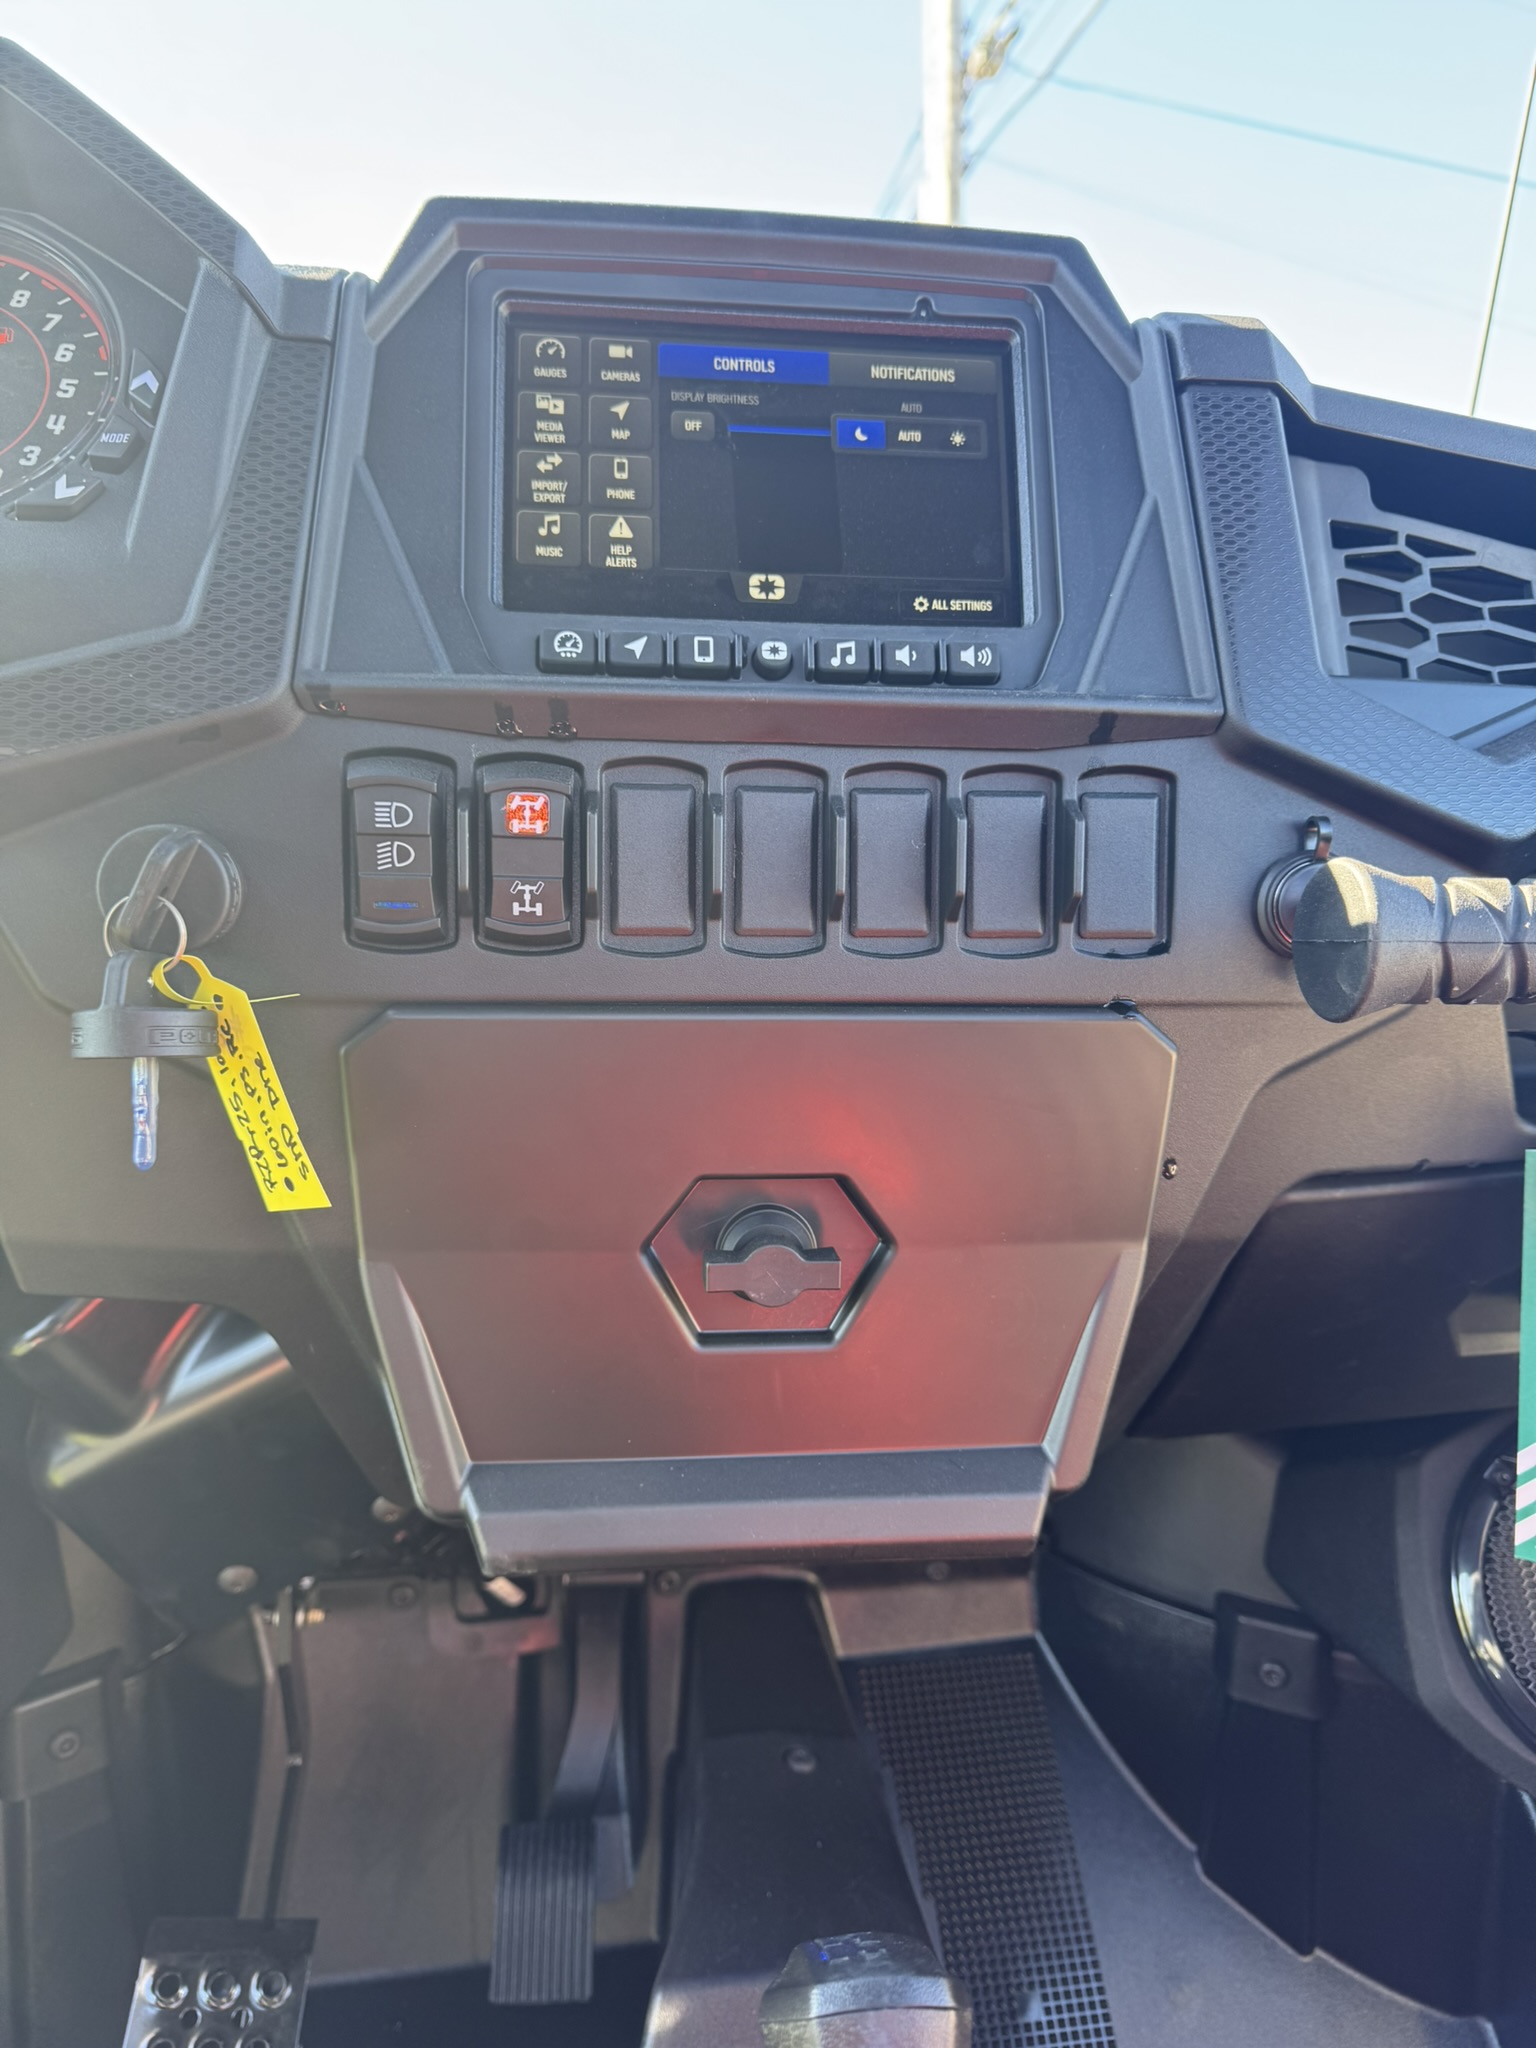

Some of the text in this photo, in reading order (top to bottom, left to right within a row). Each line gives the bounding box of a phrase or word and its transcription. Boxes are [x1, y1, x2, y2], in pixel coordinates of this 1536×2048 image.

[9, 289, 31, 308] 8
[42, 313, 63, 332] 7
[54, 343, 76, 362] 6
[713, 357, 775, 373] CONTROLS
[533, 367, 568, 379] GAUGES
[600, 371, 641, 383] CAMERAS
[870, 365, 956, 382] NOTIFICATIONS
[56, 379, 79, 398] 5
[670, 391, 759, 406] DISPLAY BRIGHTNESS
[900, 402, 923, 414] AUTO
[46, 414, 66, 435] 4
[536, 421, 564, 432] MEDIA
[684, 420, 703, 432] OFF
[100, 433, 130, 443] MODE
[534, 432, 566, 444] VIEWER
[611, 430, 631, 440] MAP
[897, 430, 922, 443] AUTO
[18, 445, 42, 466] 3
[531, 480, 568, 492] IMPORT/
[533, 492, 566, 504] EXPORT
[606, 489, 636, 500] PHONE
[535, 546, 564, 558] MUSIC
[610, 544, 633, 556] HELP
[605, 557, 637, 568] ALERTS
[931, 598, 993, 612] ALL SETTINGS
